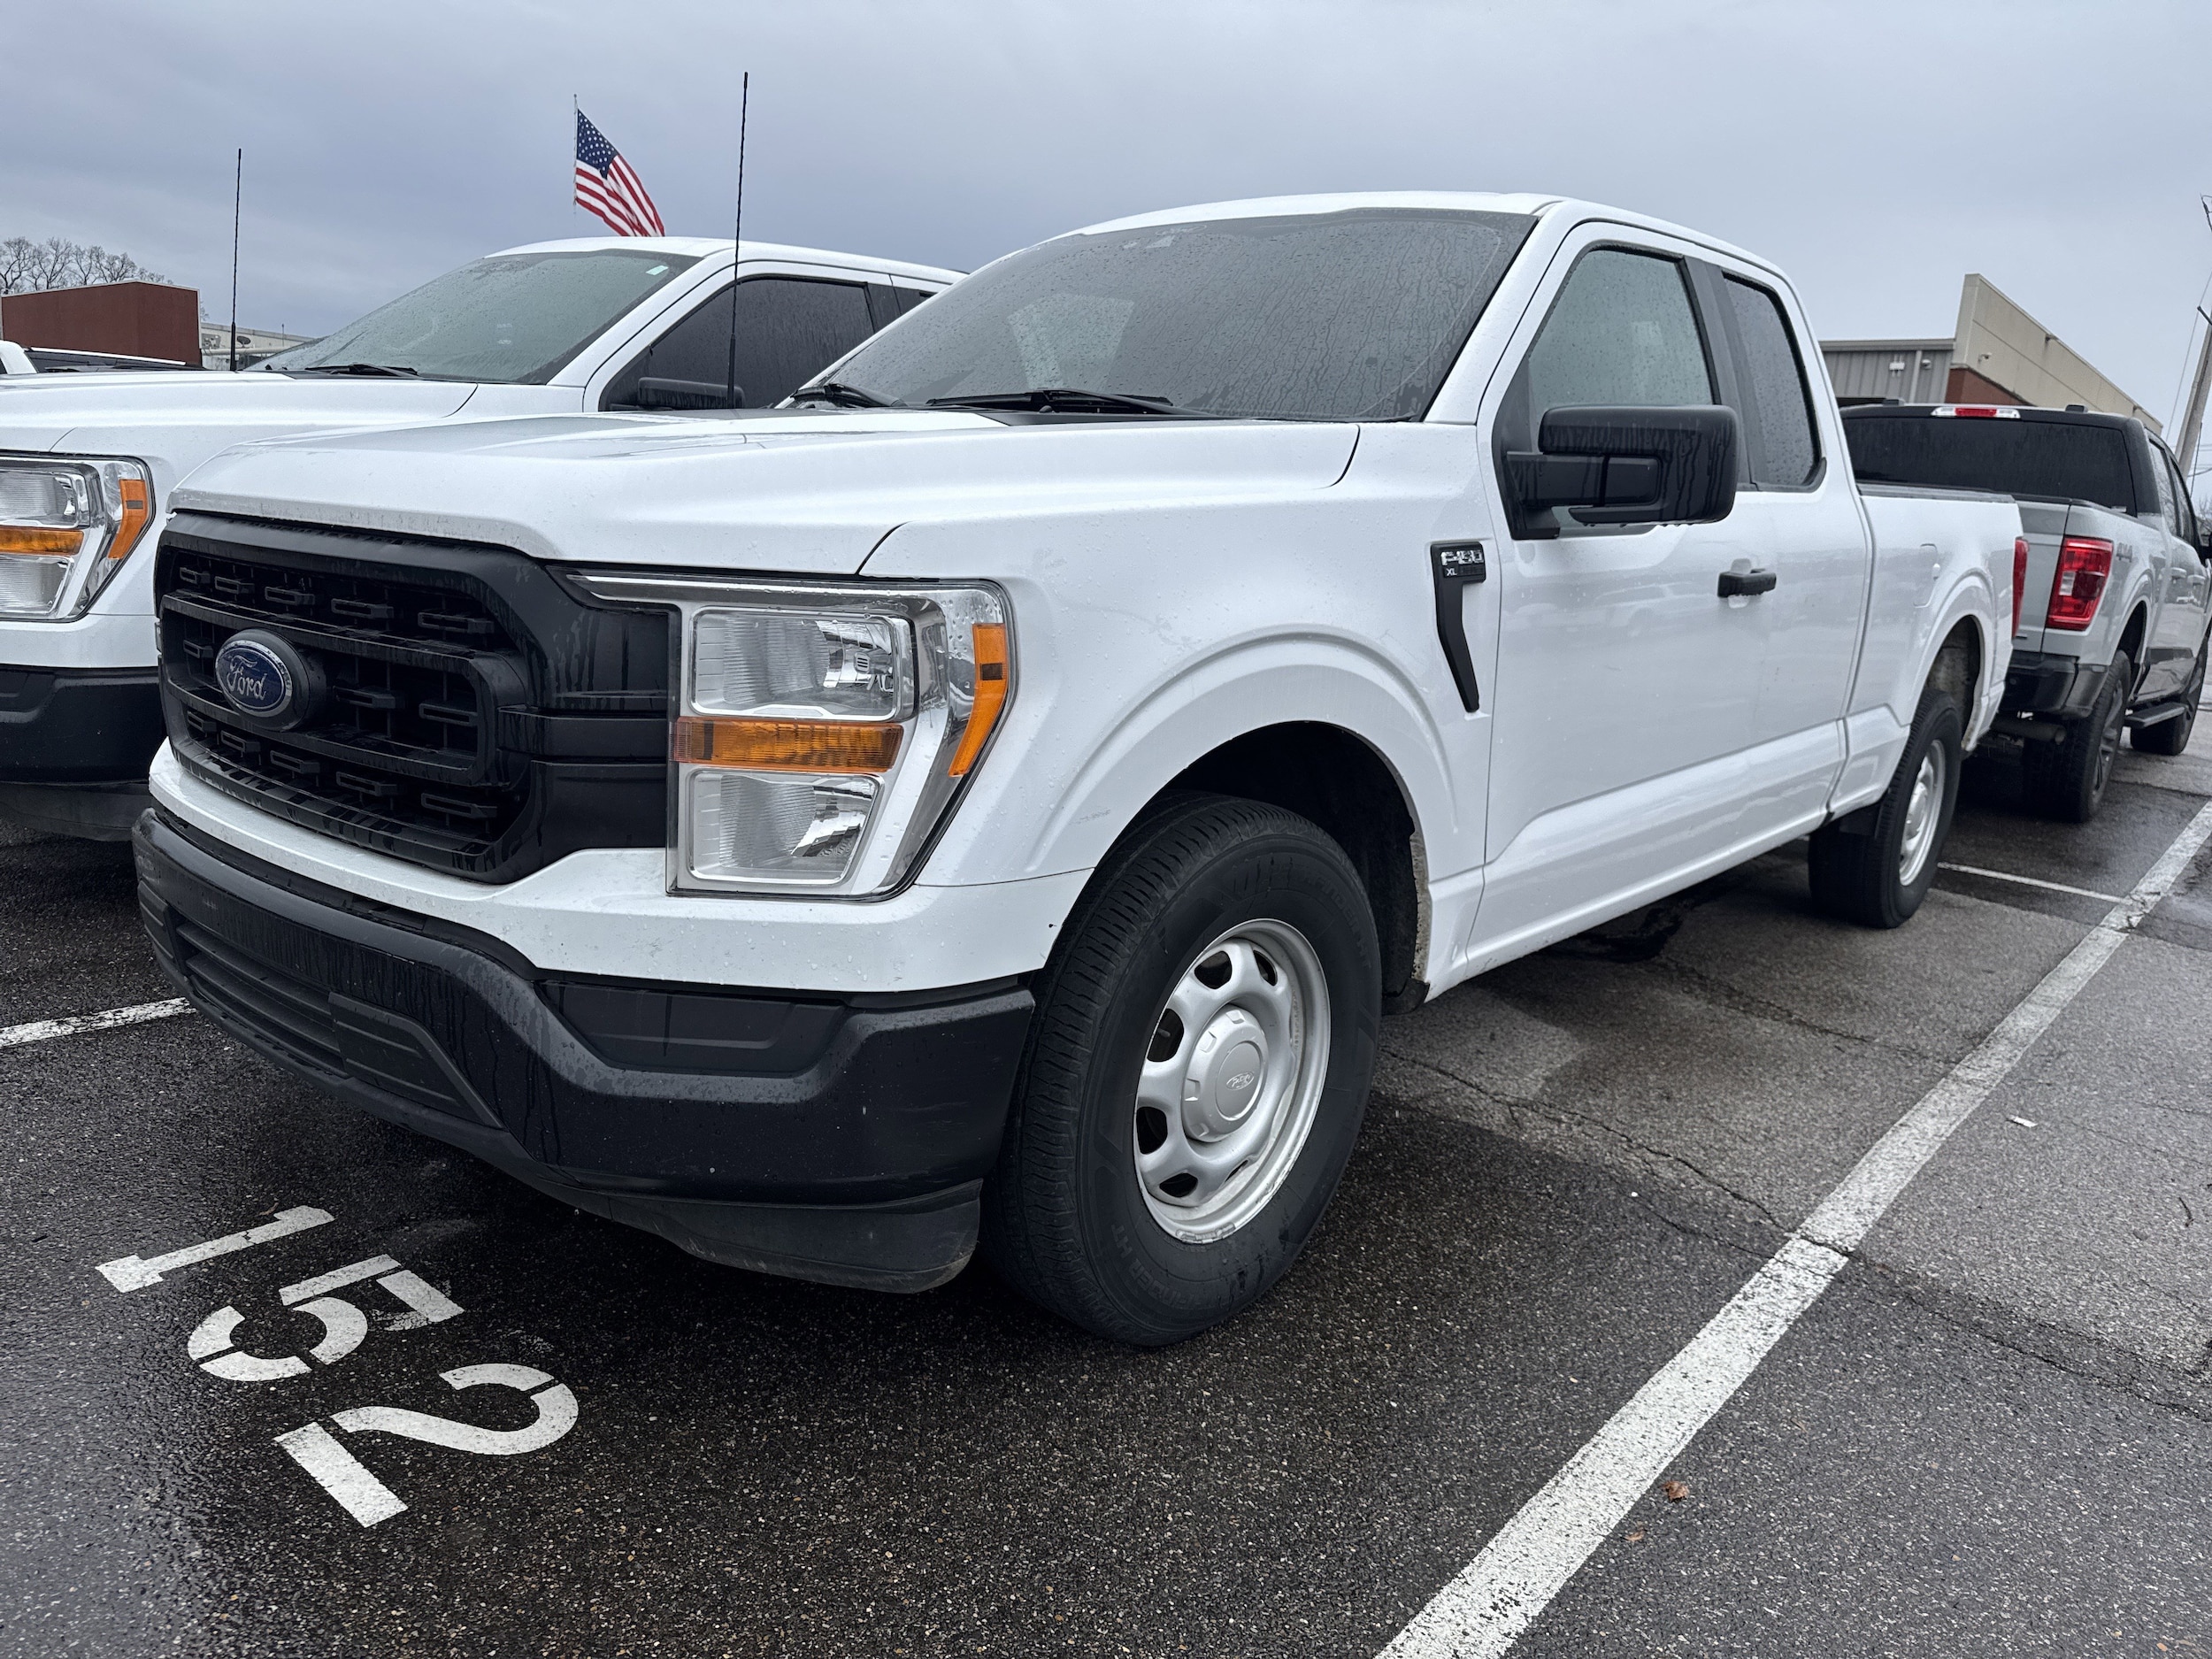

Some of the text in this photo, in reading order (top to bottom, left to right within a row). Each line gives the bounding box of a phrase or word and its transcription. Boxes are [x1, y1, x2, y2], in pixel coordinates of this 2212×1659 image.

[1440, 549, 1485, 565] F-150
[1446, 567, 1457, 576] XL
[227, 655, 268, 700] Ford
[96, 1204, 579, 1527] 152
